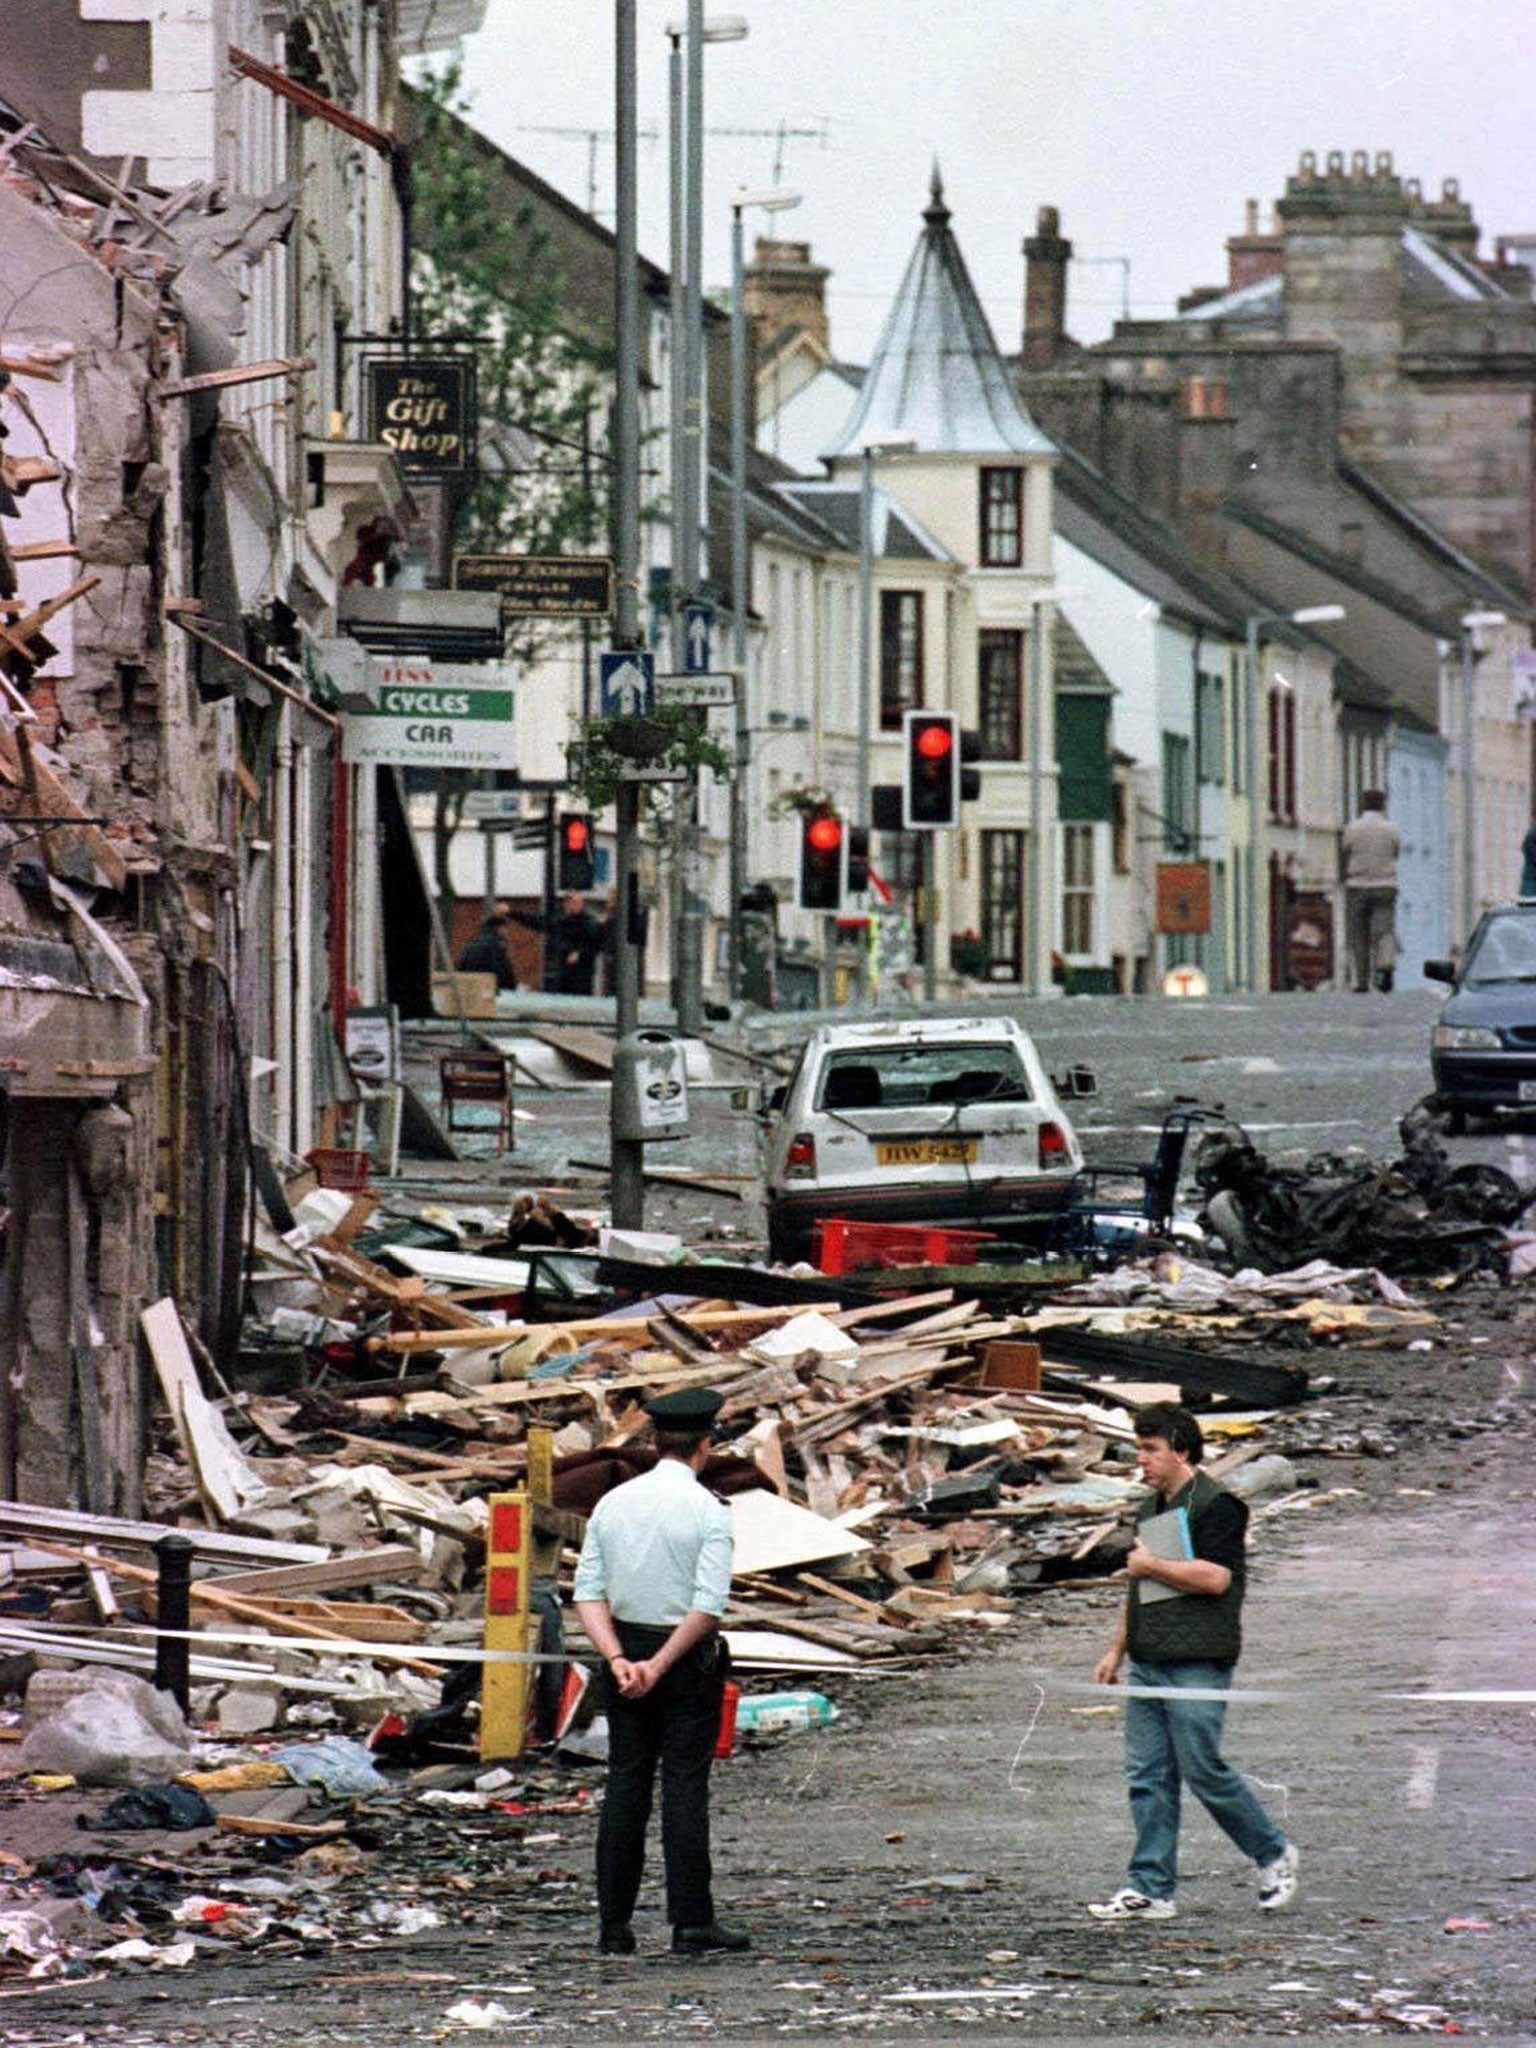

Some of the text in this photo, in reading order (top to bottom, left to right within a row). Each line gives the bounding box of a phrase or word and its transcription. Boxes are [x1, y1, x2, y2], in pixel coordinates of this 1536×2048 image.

[398, 378, 438, 395] The
[386, 398, 449, 427] Gift
[381, 427, 459, 456] Shop
[385, 691, 470, 714] CYCLES
[404, 724, 454, 744] CAR
